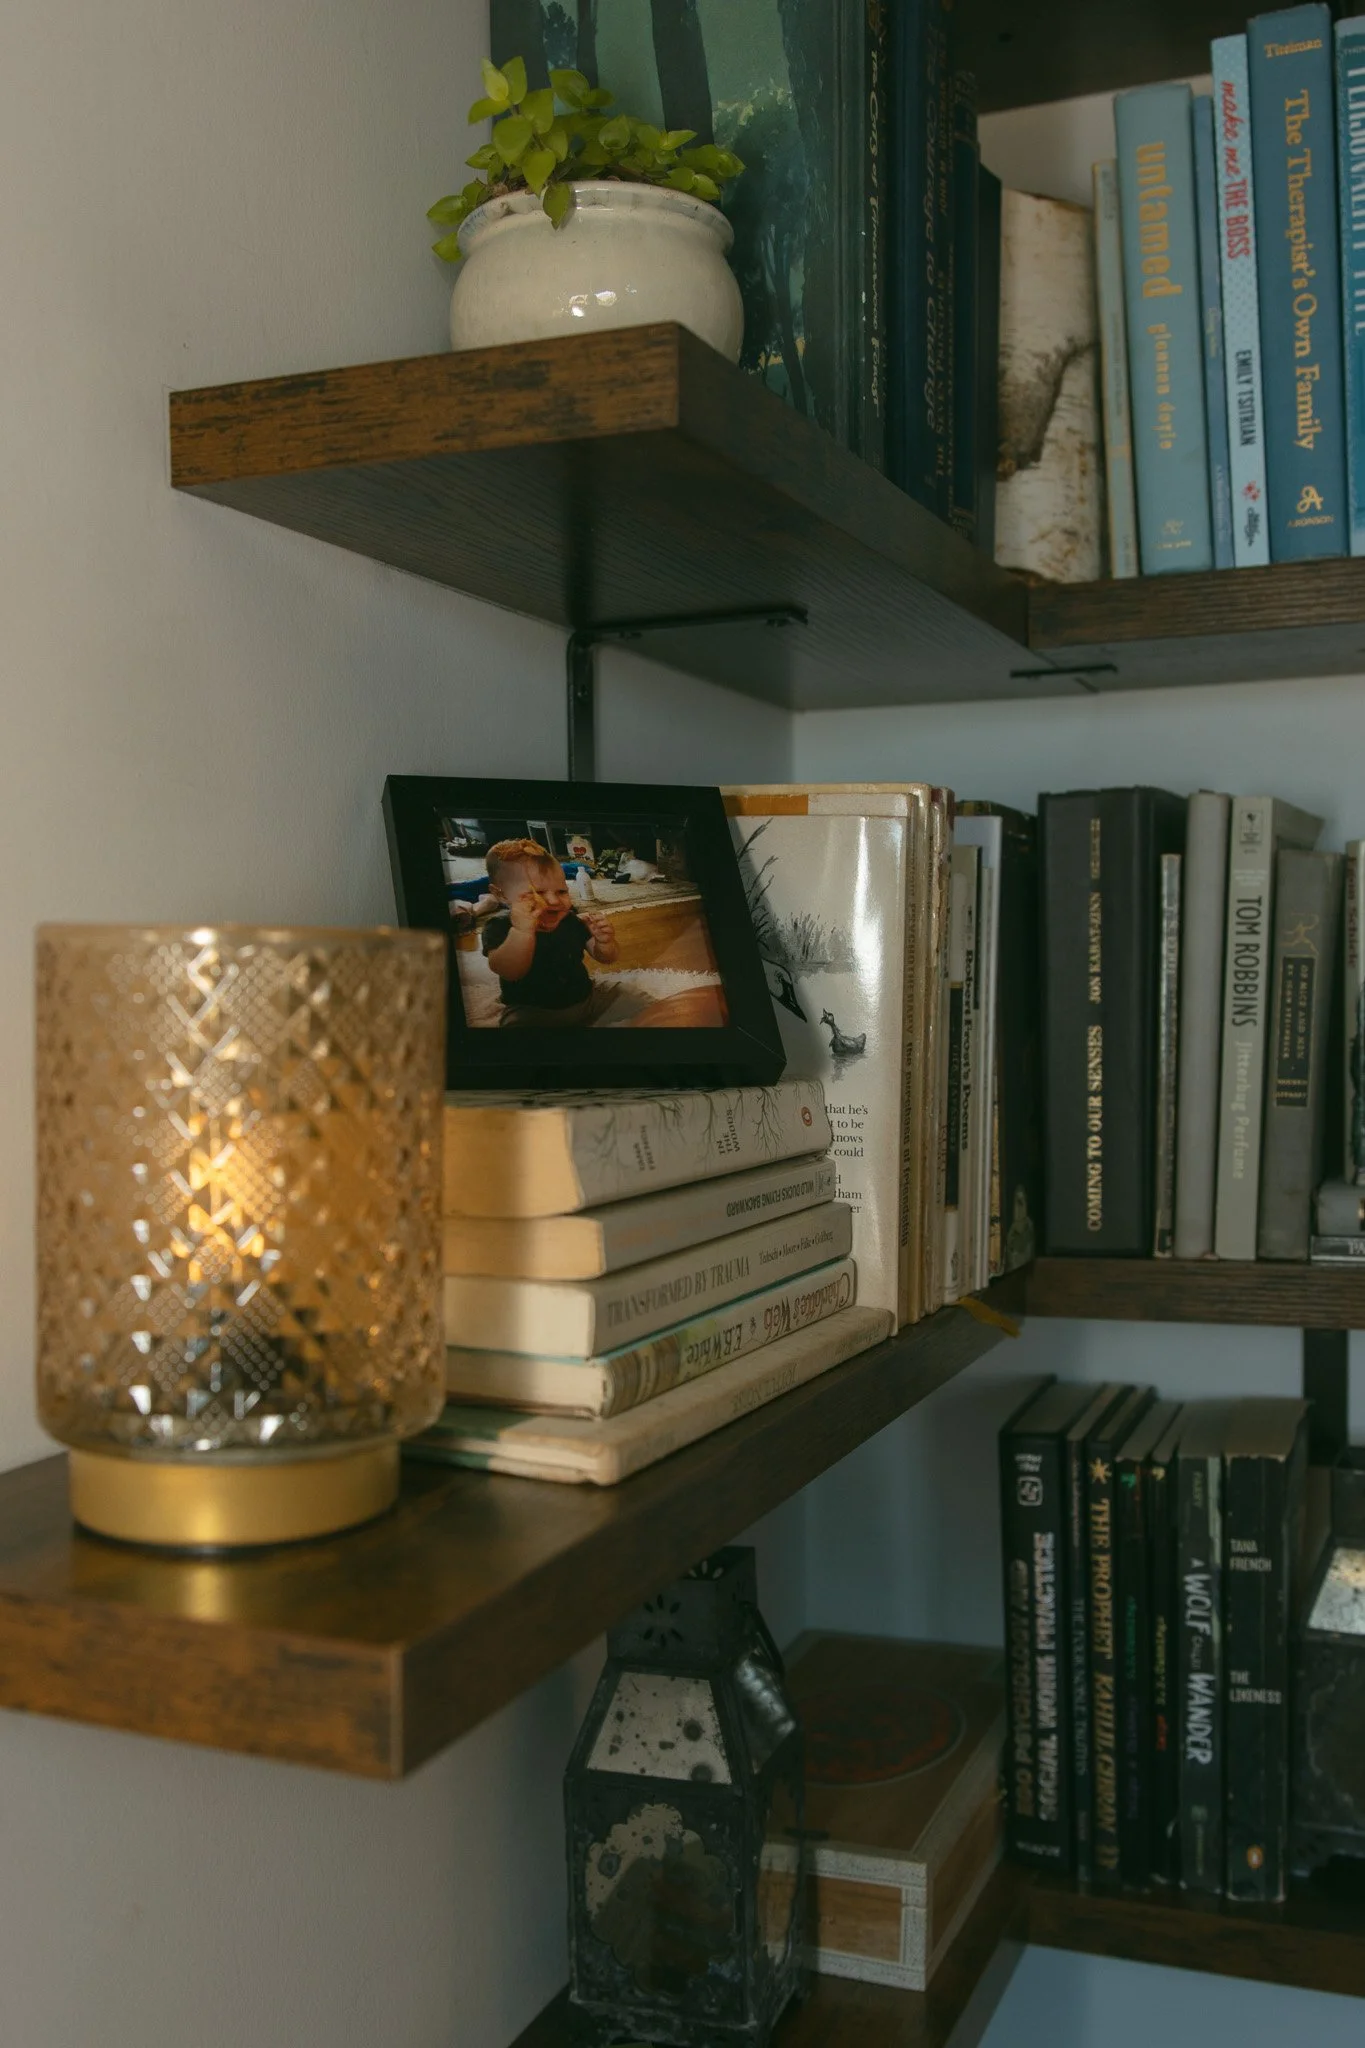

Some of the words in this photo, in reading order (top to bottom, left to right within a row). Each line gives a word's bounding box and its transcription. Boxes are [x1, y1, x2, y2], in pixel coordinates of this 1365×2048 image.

[868, 90, 881, 156] Cats
[1220, 80, 1244, 141] make
[1285, 89, 1309, 145] The
[923, 100, 937, 242] Courage
[1225, 148, 1239, 177] me
[1134, 142, 1182, 299] untamed
[1224, 178, 1247, 215] THE
[1285, 150, 1315, 288] Therapist's
[1227, 215, 1250, 259] BOSS
[926, 251, 936, 286] to
[936, 269, 944, 371] PRINCIPLES
[1293, 294, 1318, 357] Own
[870, 336, 881, 418] Forest
[924, 297, 937, 431] Change
[1145, 323, 1172, 396] glennon
[1235, 349, 1253, 391] EMILY
[936, 380, 944, 435] SEVEN
[1151, 401, 1177, 451] doyle
[1237, 391, 1257, 446] TSITRIAN
[1294, 363, 1323, 450] Family
[1088, 892, 1102, 972] KABAT-ZINN
[1236, 896, 1262, 936] TOM
[906, 903, 916, 1034] PSYCHOTHERAPY
[964, 949, 973, 1016] Robert
[1088, 976, 1102, 1004] JON
[1232, 942, 1260, 1028] ROBBINS
[1299, 981, 1308, 1008] MICE
[1297, 1036, 1305, 1060] MEN
[1298, 1010, 1307, 1033] AND
[963, 1019, 972, 1081] Frost's
[1088, 1025, 1103, 1091] SENSES
[1230, 1041, 1253, 1111] Jitterbug
[726, 1110, 740, 1152] WOODS
[837, 1119, 848, 1129] to
[851, 1118, 864, 1129] be
[848, 1104, 868, 1115] he's
[961, 1084, 971, 1151] Poems
[1088, 1096, 1103, 1131] OUR
[717, 1140, 725, 1155] IN
[722, 1132, 734, 1153] THE
[834, 1147, 863, 1157] could
[1087, 1136, 1102, 1158] TO
[1231, 1117, 1250, 1178] Perfume
[726, 1193, 762, 1217] BACKWARD
[761, 1188, 781, 1208] FLYING
[782, 1183, 801, 1202] DUCKS
[800, 1179, 815, 1197] WILD
[1087, 1164, 1102, 1231] COMING
[607, 1269, 692, 1328] TRANSFORMED
[695, 1268, 709, 1294] BY
[710, 1256, 751, 1290] TRAUMA
[763, 1296, 789, 1339] Web
[795, 1272, 850, 1325] Charlotte's
[686, 1331, 722, 1366] White
[1090, 1499, 1110, 1549] THE
[1230, 1539, 1258, 1554] TANA
[1010, 1559, 1029, 1611] AND
[1191, 1558, 1204, 1568] A
[1230, 1557, 1272, 1572] FRENCH
[1033, 1532, 1055, 1650] PRACTICE
[1091, 1553, 1114, 1660] PROPHET
[1183, 1573, 1212, 1635] WOLF
[1012, 1618, 1032, 1764] PSYCHOLOGY
[1037, 1655, 1057, 1729] WORK
[1230, 1670, 1249, 1685] THE
[1230, 1689, 1282, 1704] LIKENESS
[1094, 1673, 1116, 1750] KAHLIL
[1185, 1671, 1216, 1765] WANDER
[1039, 1734, 1058, 1821] SOCIAL
